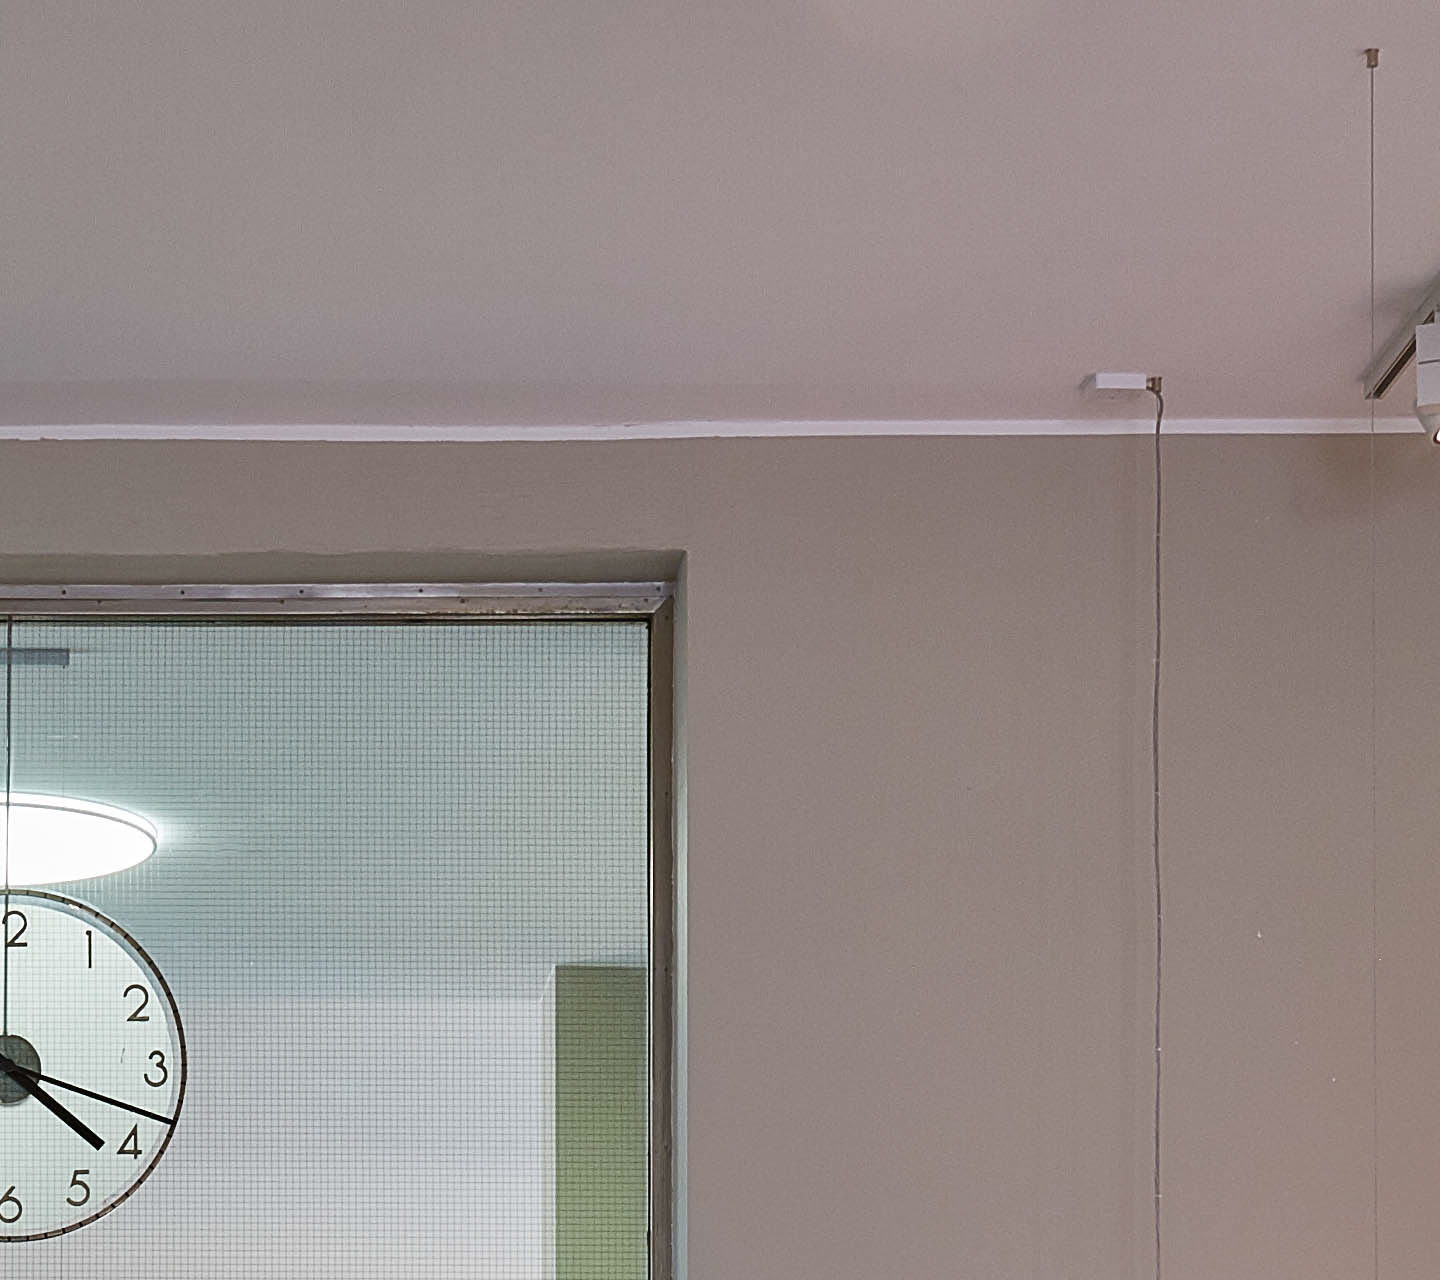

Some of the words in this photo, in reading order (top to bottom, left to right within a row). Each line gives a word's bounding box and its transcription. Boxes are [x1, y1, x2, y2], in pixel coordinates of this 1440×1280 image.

[86, 930, 92, 968] 1
[122, 984, 149, 1022] 2
[144, 1050, 168, 1086] 3
[117, 1124, 142, 1160] 4
[66, 1169, 90, 1206] 5
